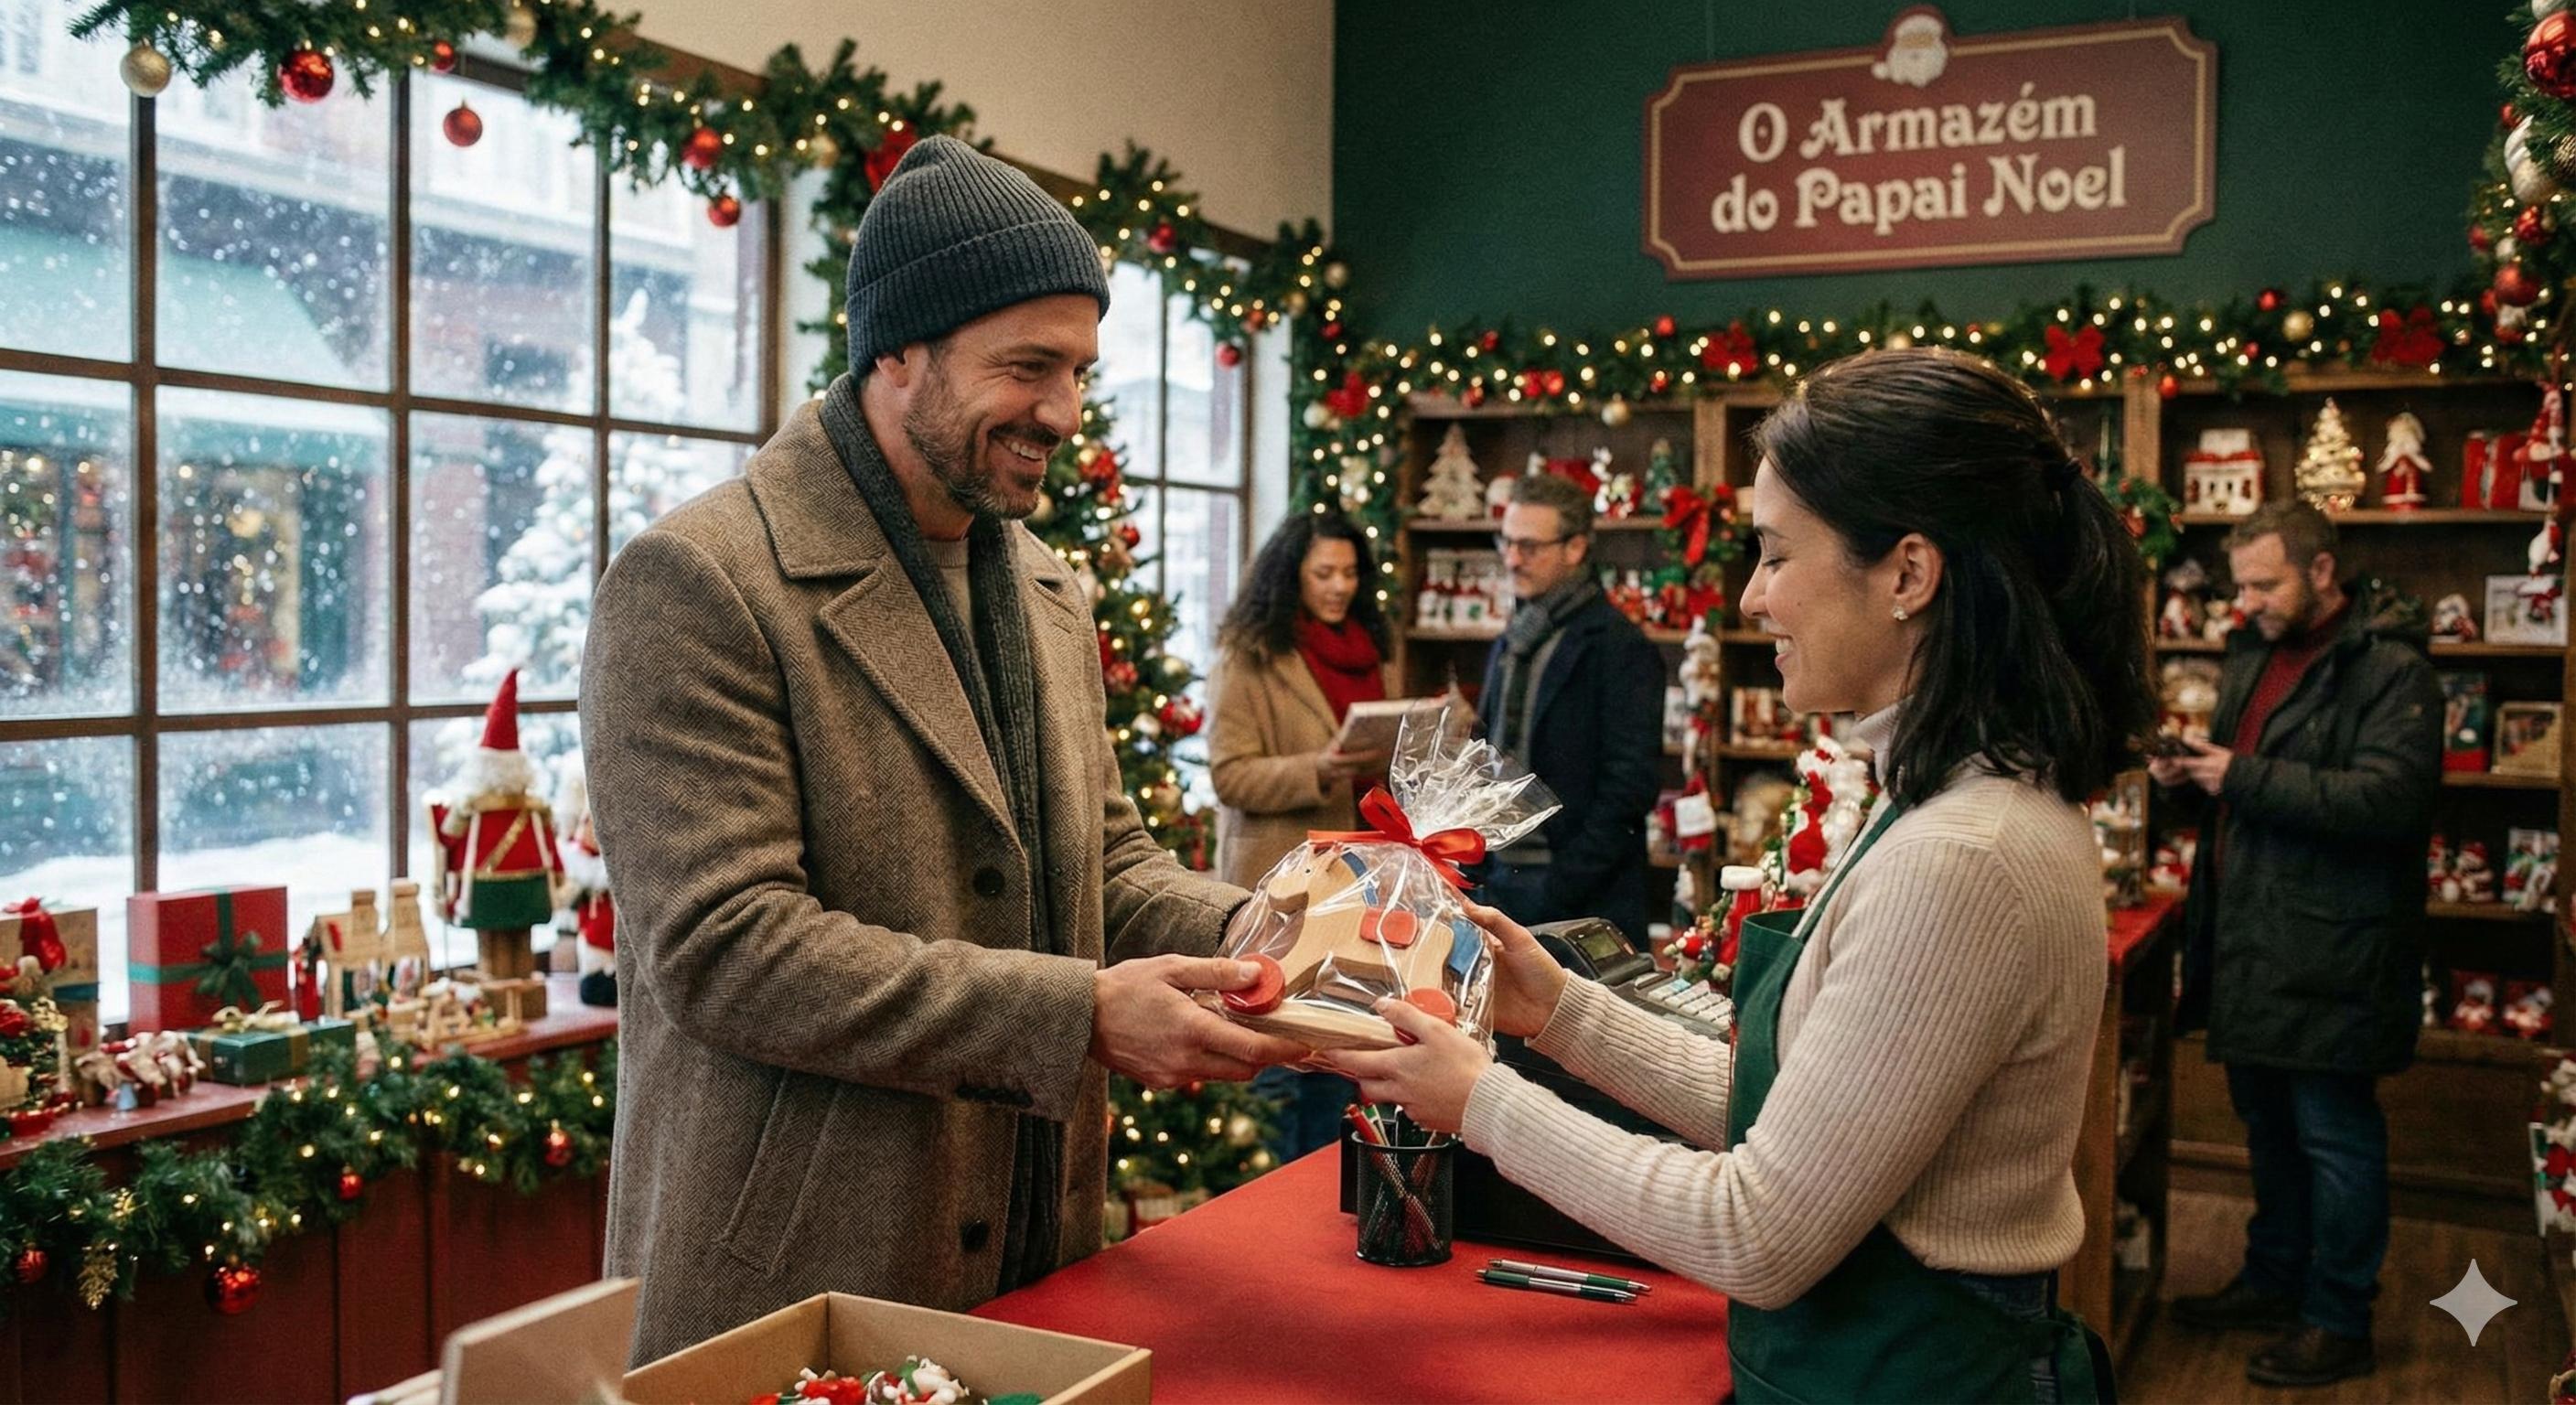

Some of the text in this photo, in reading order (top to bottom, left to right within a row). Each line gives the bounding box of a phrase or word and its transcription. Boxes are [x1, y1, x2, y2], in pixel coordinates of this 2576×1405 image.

[1738, 82, 2097, 163] O Armazém
[1711, 145, 2127, 236] do Papai Noel
